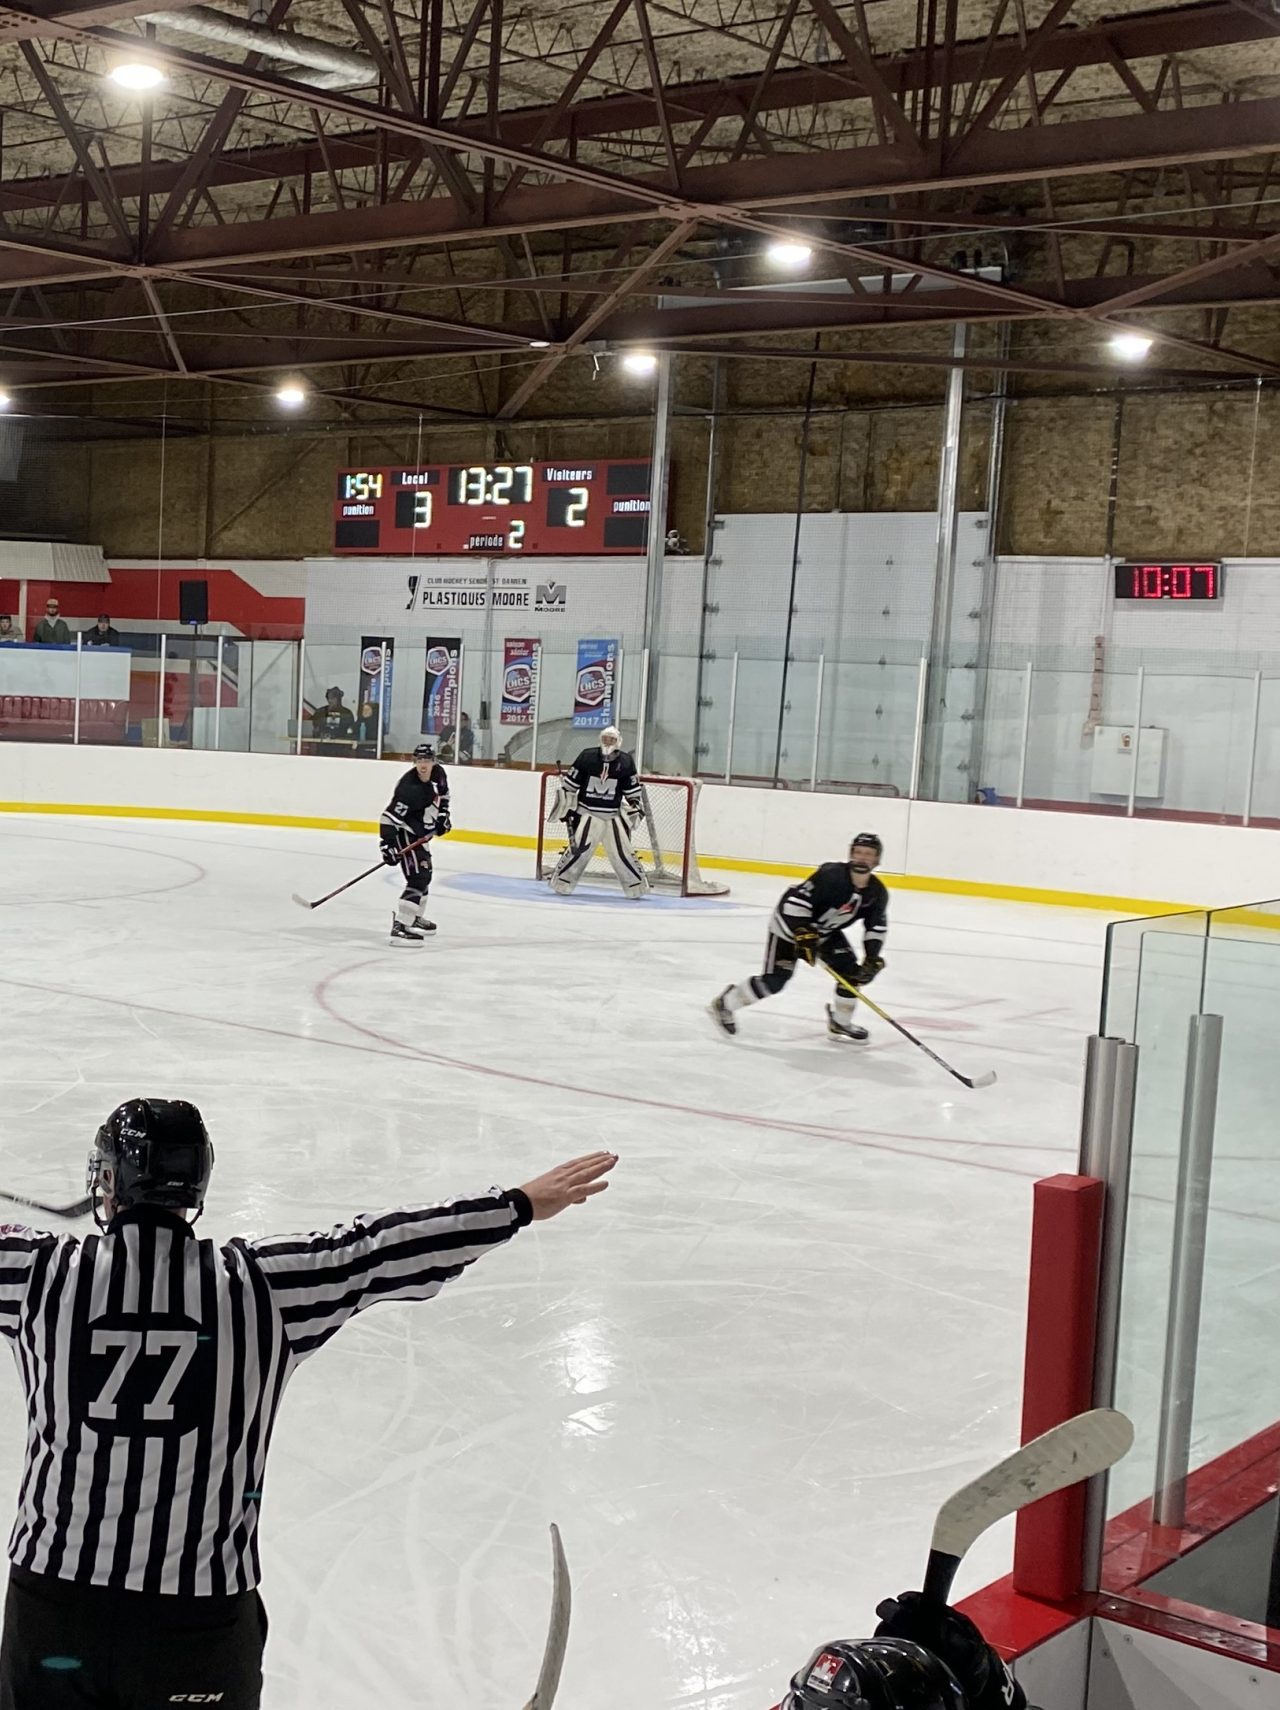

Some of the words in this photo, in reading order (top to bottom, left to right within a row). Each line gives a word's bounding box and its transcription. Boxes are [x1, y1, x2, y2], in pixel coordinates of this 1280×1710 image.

[402, 472, 428, 485] Local
[546, 468, 593, 481] Visiteurs
[345, 473, 383, 500] 1:54
[458, 466, 533, 505] 13:27
[342, 504, 375, 517] punition
[414, 491, 433, 529] 3
[565, 487, 589, 528] 2
[507, 520, 526, 549] 2
[1133, 566, 1214, 598] 10:07
[423, 591, 486, 606] PLASTIQUES
[492, 592, 529, 606] MOORE
[441, 649, 458, 726] champions
[507, 677, 531, 689] LHCS
[580, 679, 605, 692] LHCS
[601, 643, 615, 726] champions
[574, 716, 599, 726] 2017
[120, 1128, 147, 1138] CCM
[87, 1329, 198, 1421] 77
[169, 1692, 224, 1703] CCM
